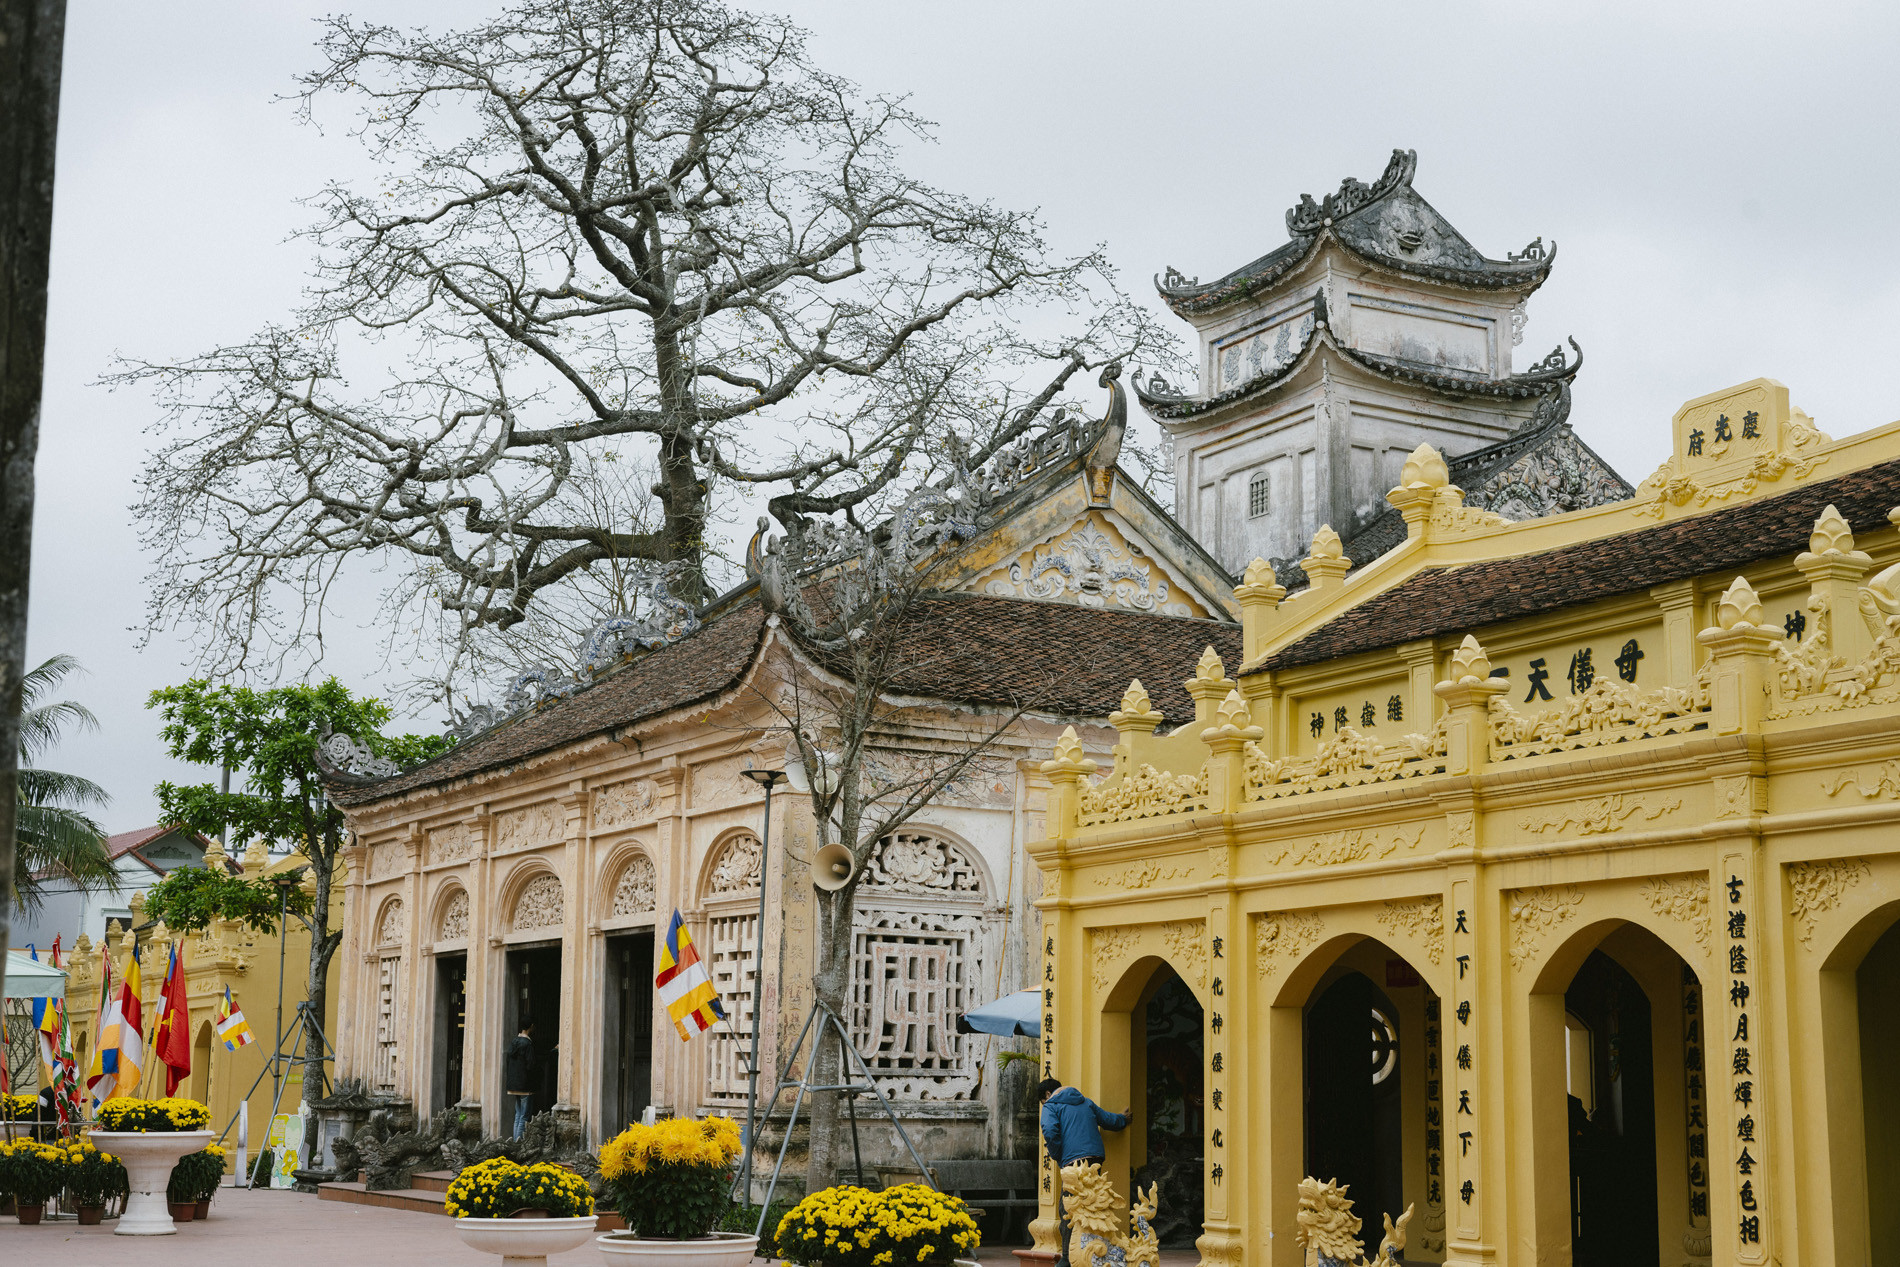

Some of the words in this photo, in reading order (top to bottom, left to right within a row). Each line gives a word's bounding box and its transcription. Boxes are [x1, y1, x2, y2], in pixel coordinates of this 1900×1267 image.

[1489, 639, 1644, 703] 母儀天
[1455, 910, 1475, 1205] 天下母儀天下母
